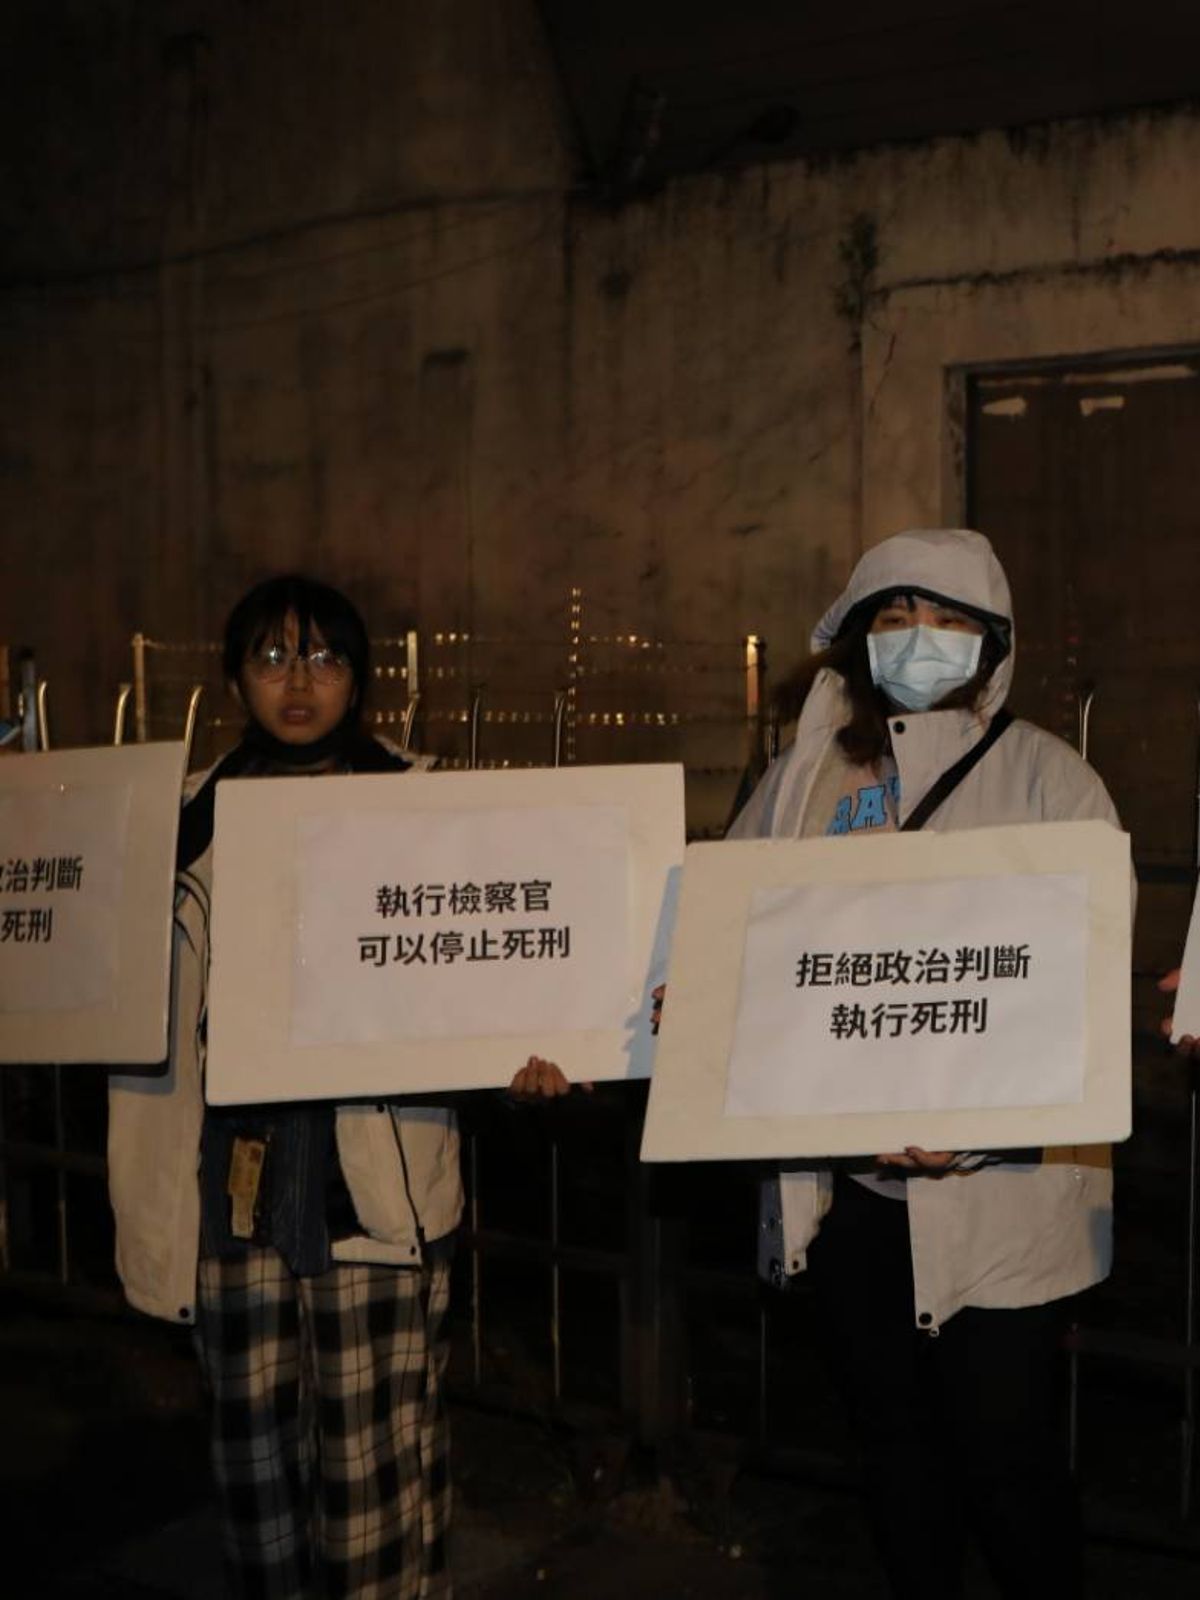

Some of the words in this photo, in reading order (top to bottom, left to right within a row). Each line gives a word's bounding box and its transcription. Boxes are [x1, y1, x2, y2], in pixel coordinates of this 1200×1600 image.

[0, 855, 83, 894] 治判斷
[375, 878, 553, 919] 執行檢察官
[1, 907, 53, 943] 死刑
[357, 925, 571, 968] 可以停止死刑
[795, 943, 1032, 988] 拒絕政治判斷
[829, 997, 988, 1040] 執行死刑
